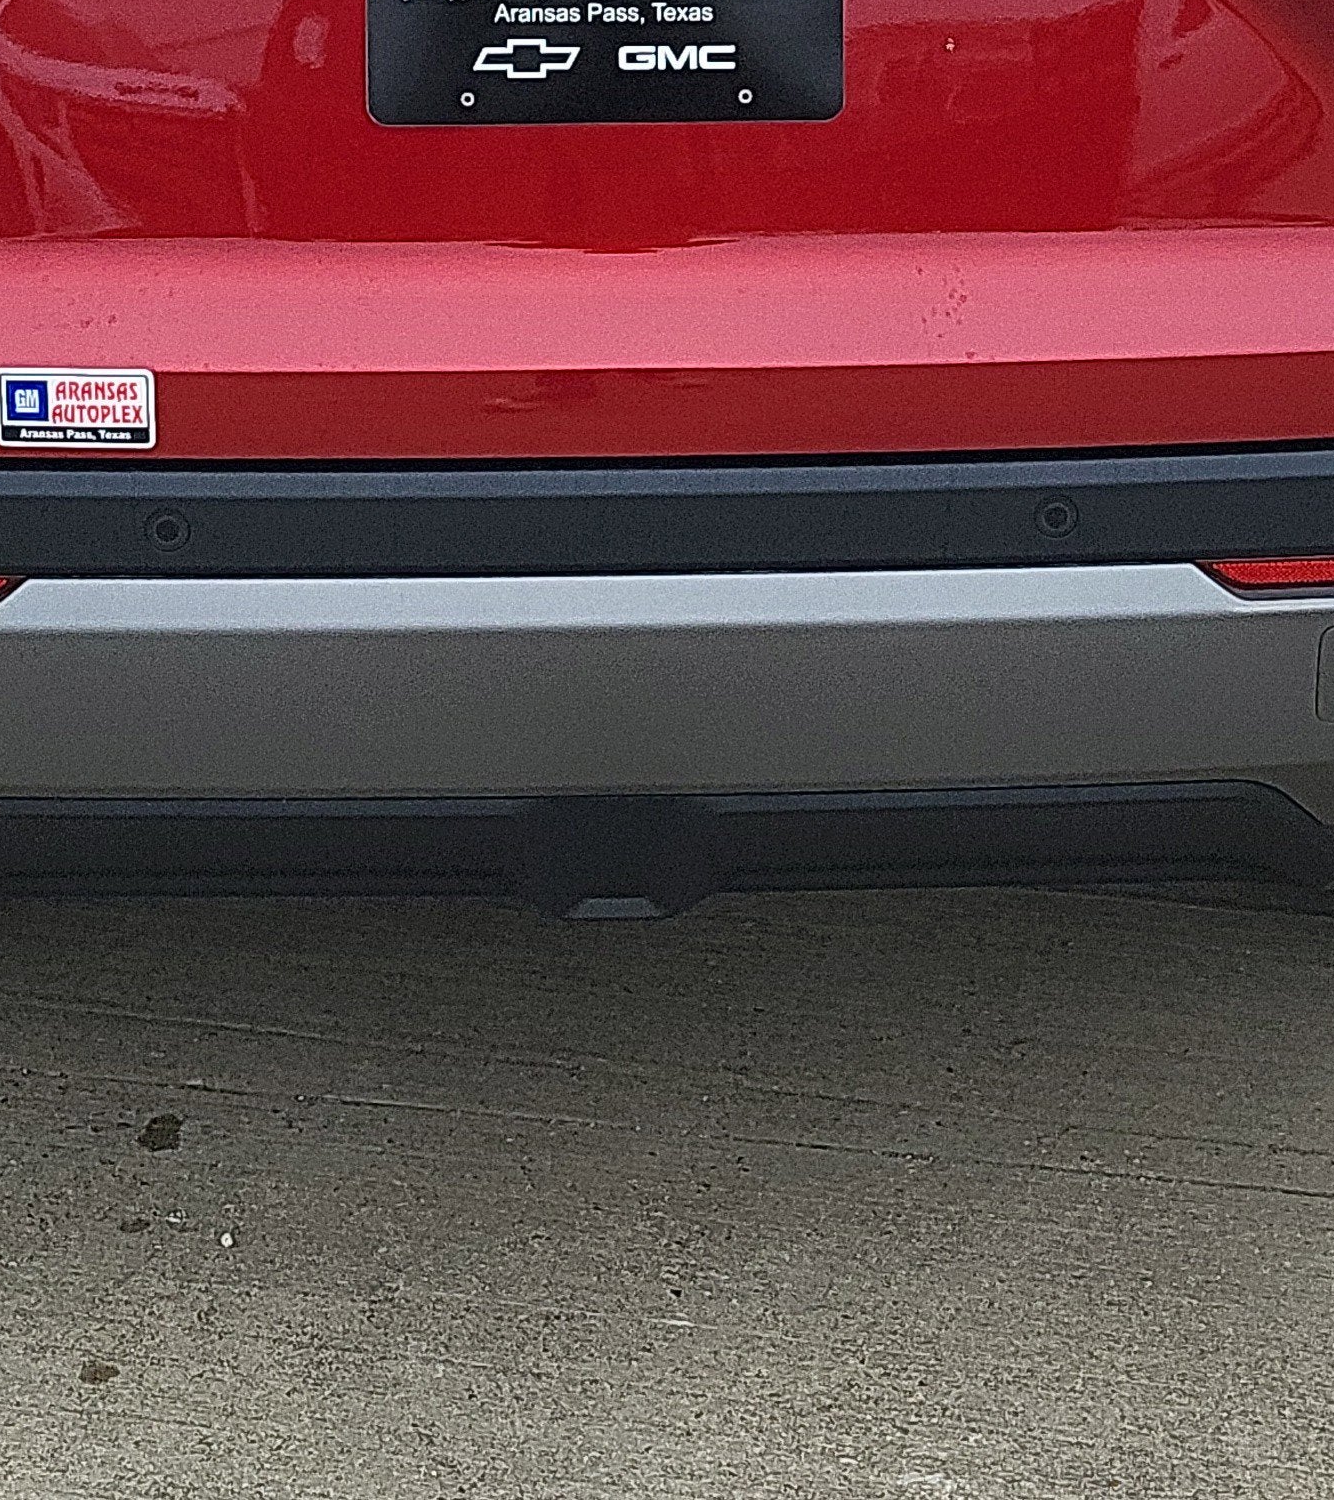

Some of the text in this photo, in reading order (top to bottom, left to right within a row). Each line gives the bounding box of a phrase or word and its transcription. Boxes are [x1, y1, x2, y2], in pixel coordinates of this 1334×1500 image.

[494, 2, 714, 25] Aransas Pass, Texas
[618, 44, 736, 71] GMC
[14, 388, 40, 410] GM
[55, 381, 138, 402] ARANSAS
[52, 404, 143, 424] AUTOPLEX
[19, 428, 64, 440] Aransas
[98, 429, 132, 440] Texas
